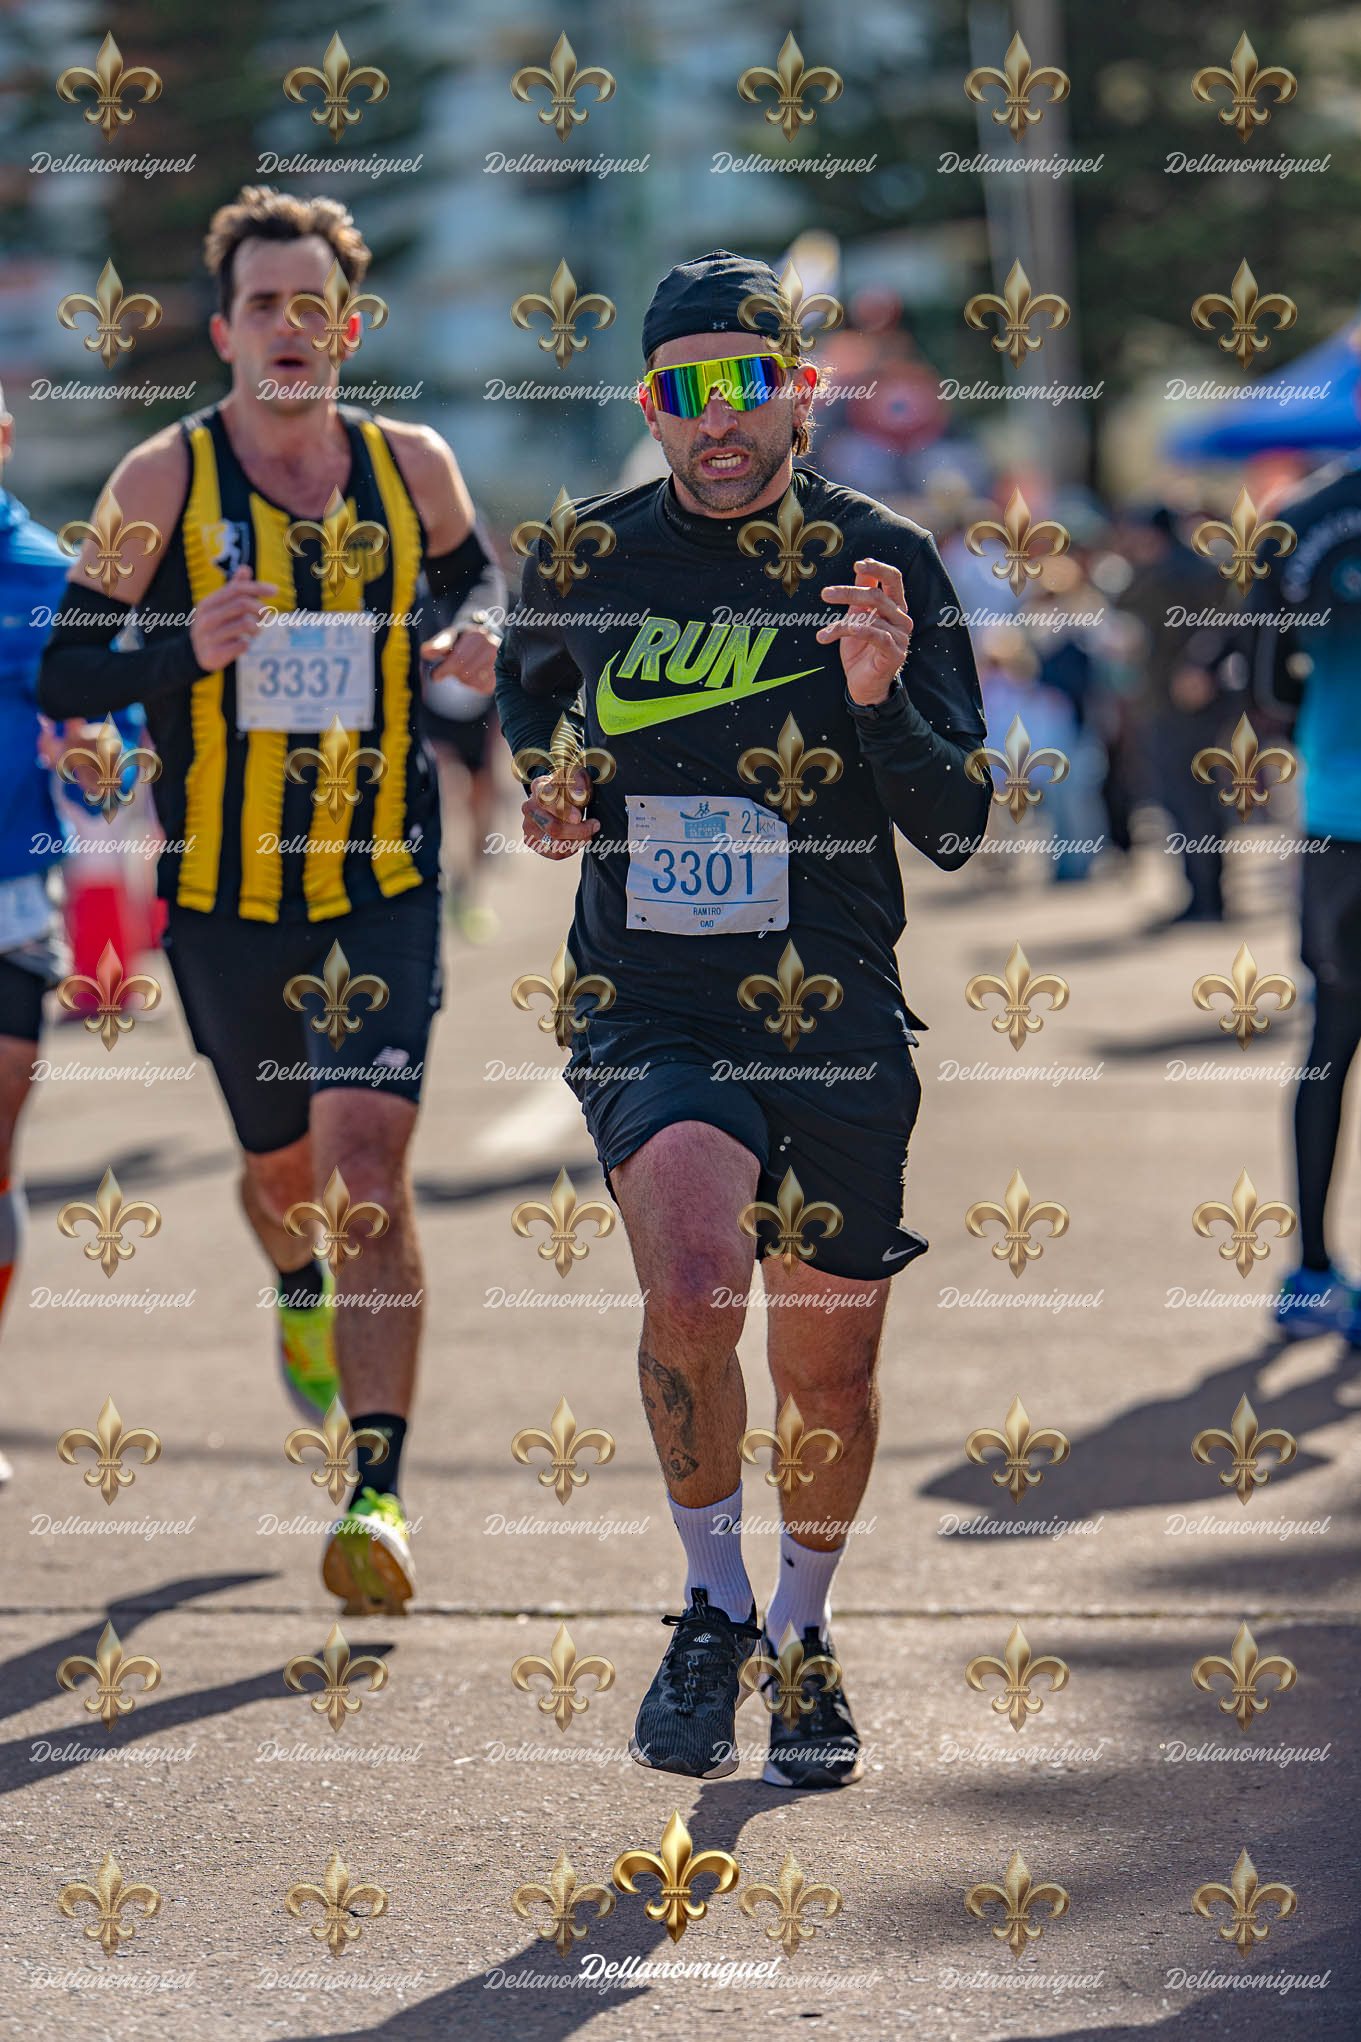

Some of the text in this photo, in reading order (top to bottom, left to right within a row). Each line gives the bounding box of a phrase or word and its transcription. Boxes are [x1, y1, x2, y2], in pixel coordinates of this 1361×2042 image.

[616, 617, 779, 690] RUN
[258, 657, 351, 698] 3337
[652, 848, 753, 896] 3301
[693, 907, 721, 916] RAMIRO
